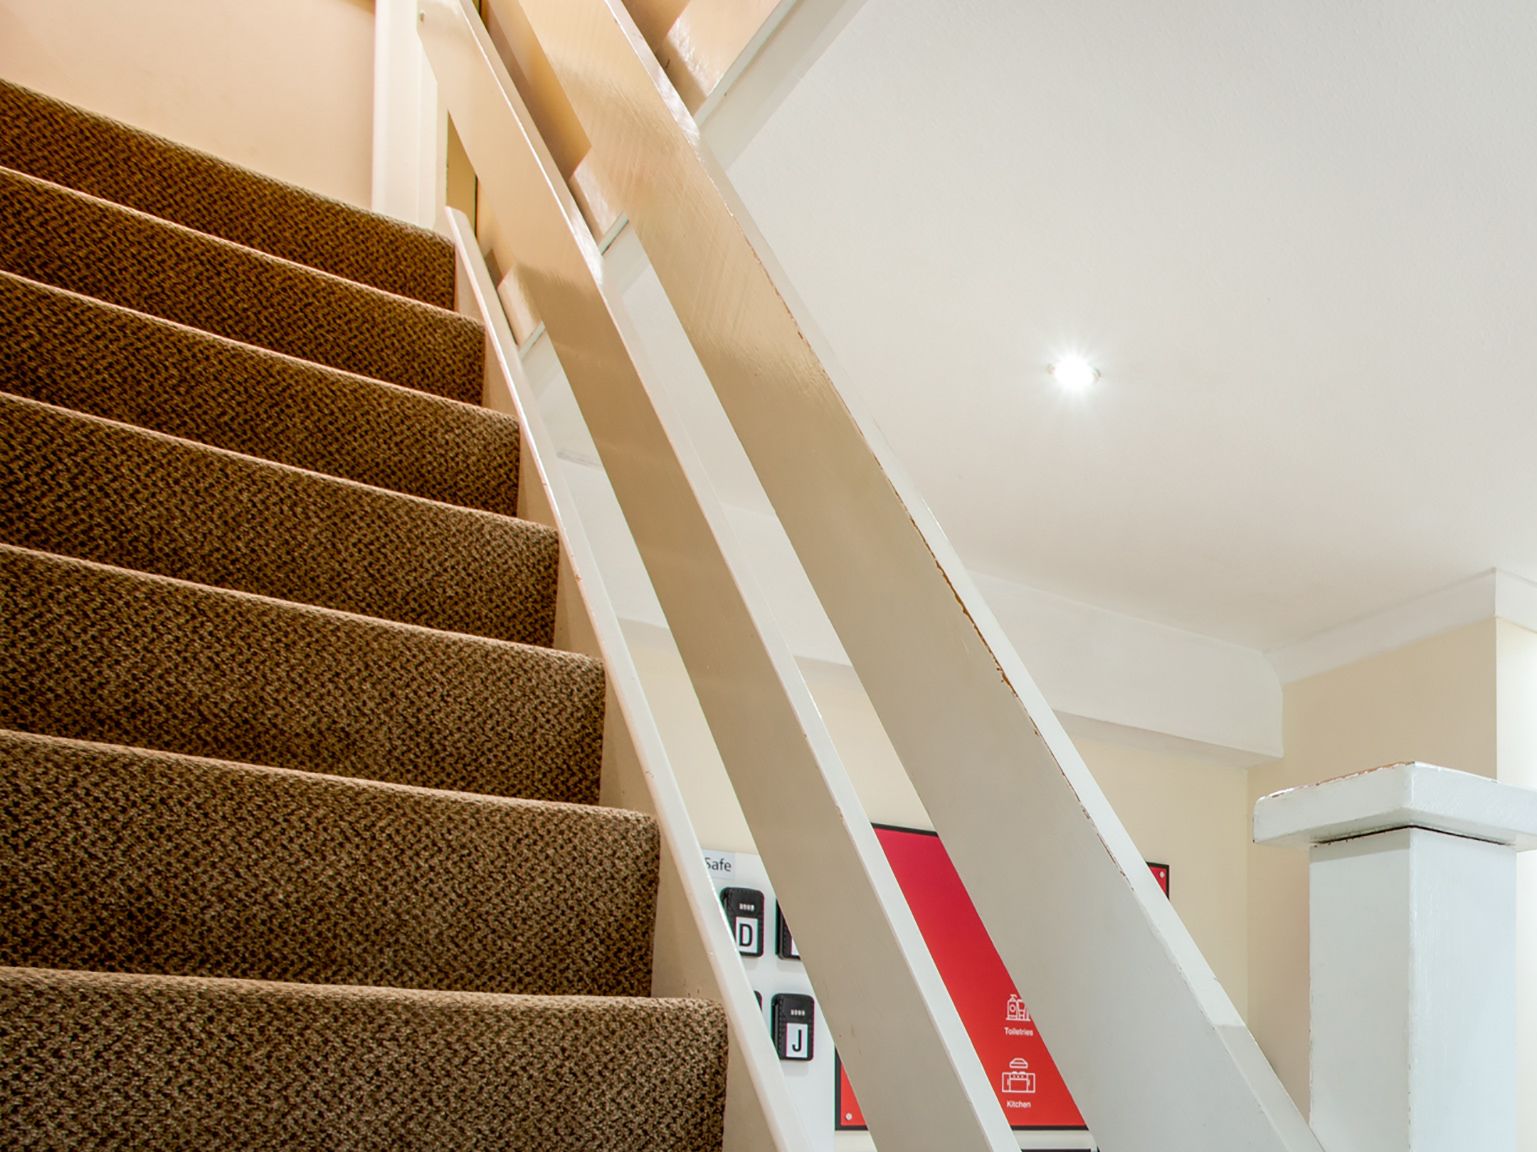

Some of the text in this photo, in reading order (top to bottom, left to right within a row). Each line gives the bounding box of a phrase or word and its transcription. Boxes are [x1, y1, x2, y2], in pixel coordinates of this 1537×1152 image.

[738, 923, 753, 947] D
[1004, 1027, 1034, 1036] Toiletries
[792, 1029, 803, 1052] J
[1006, 1100, 1032, 1109] Kitchen
